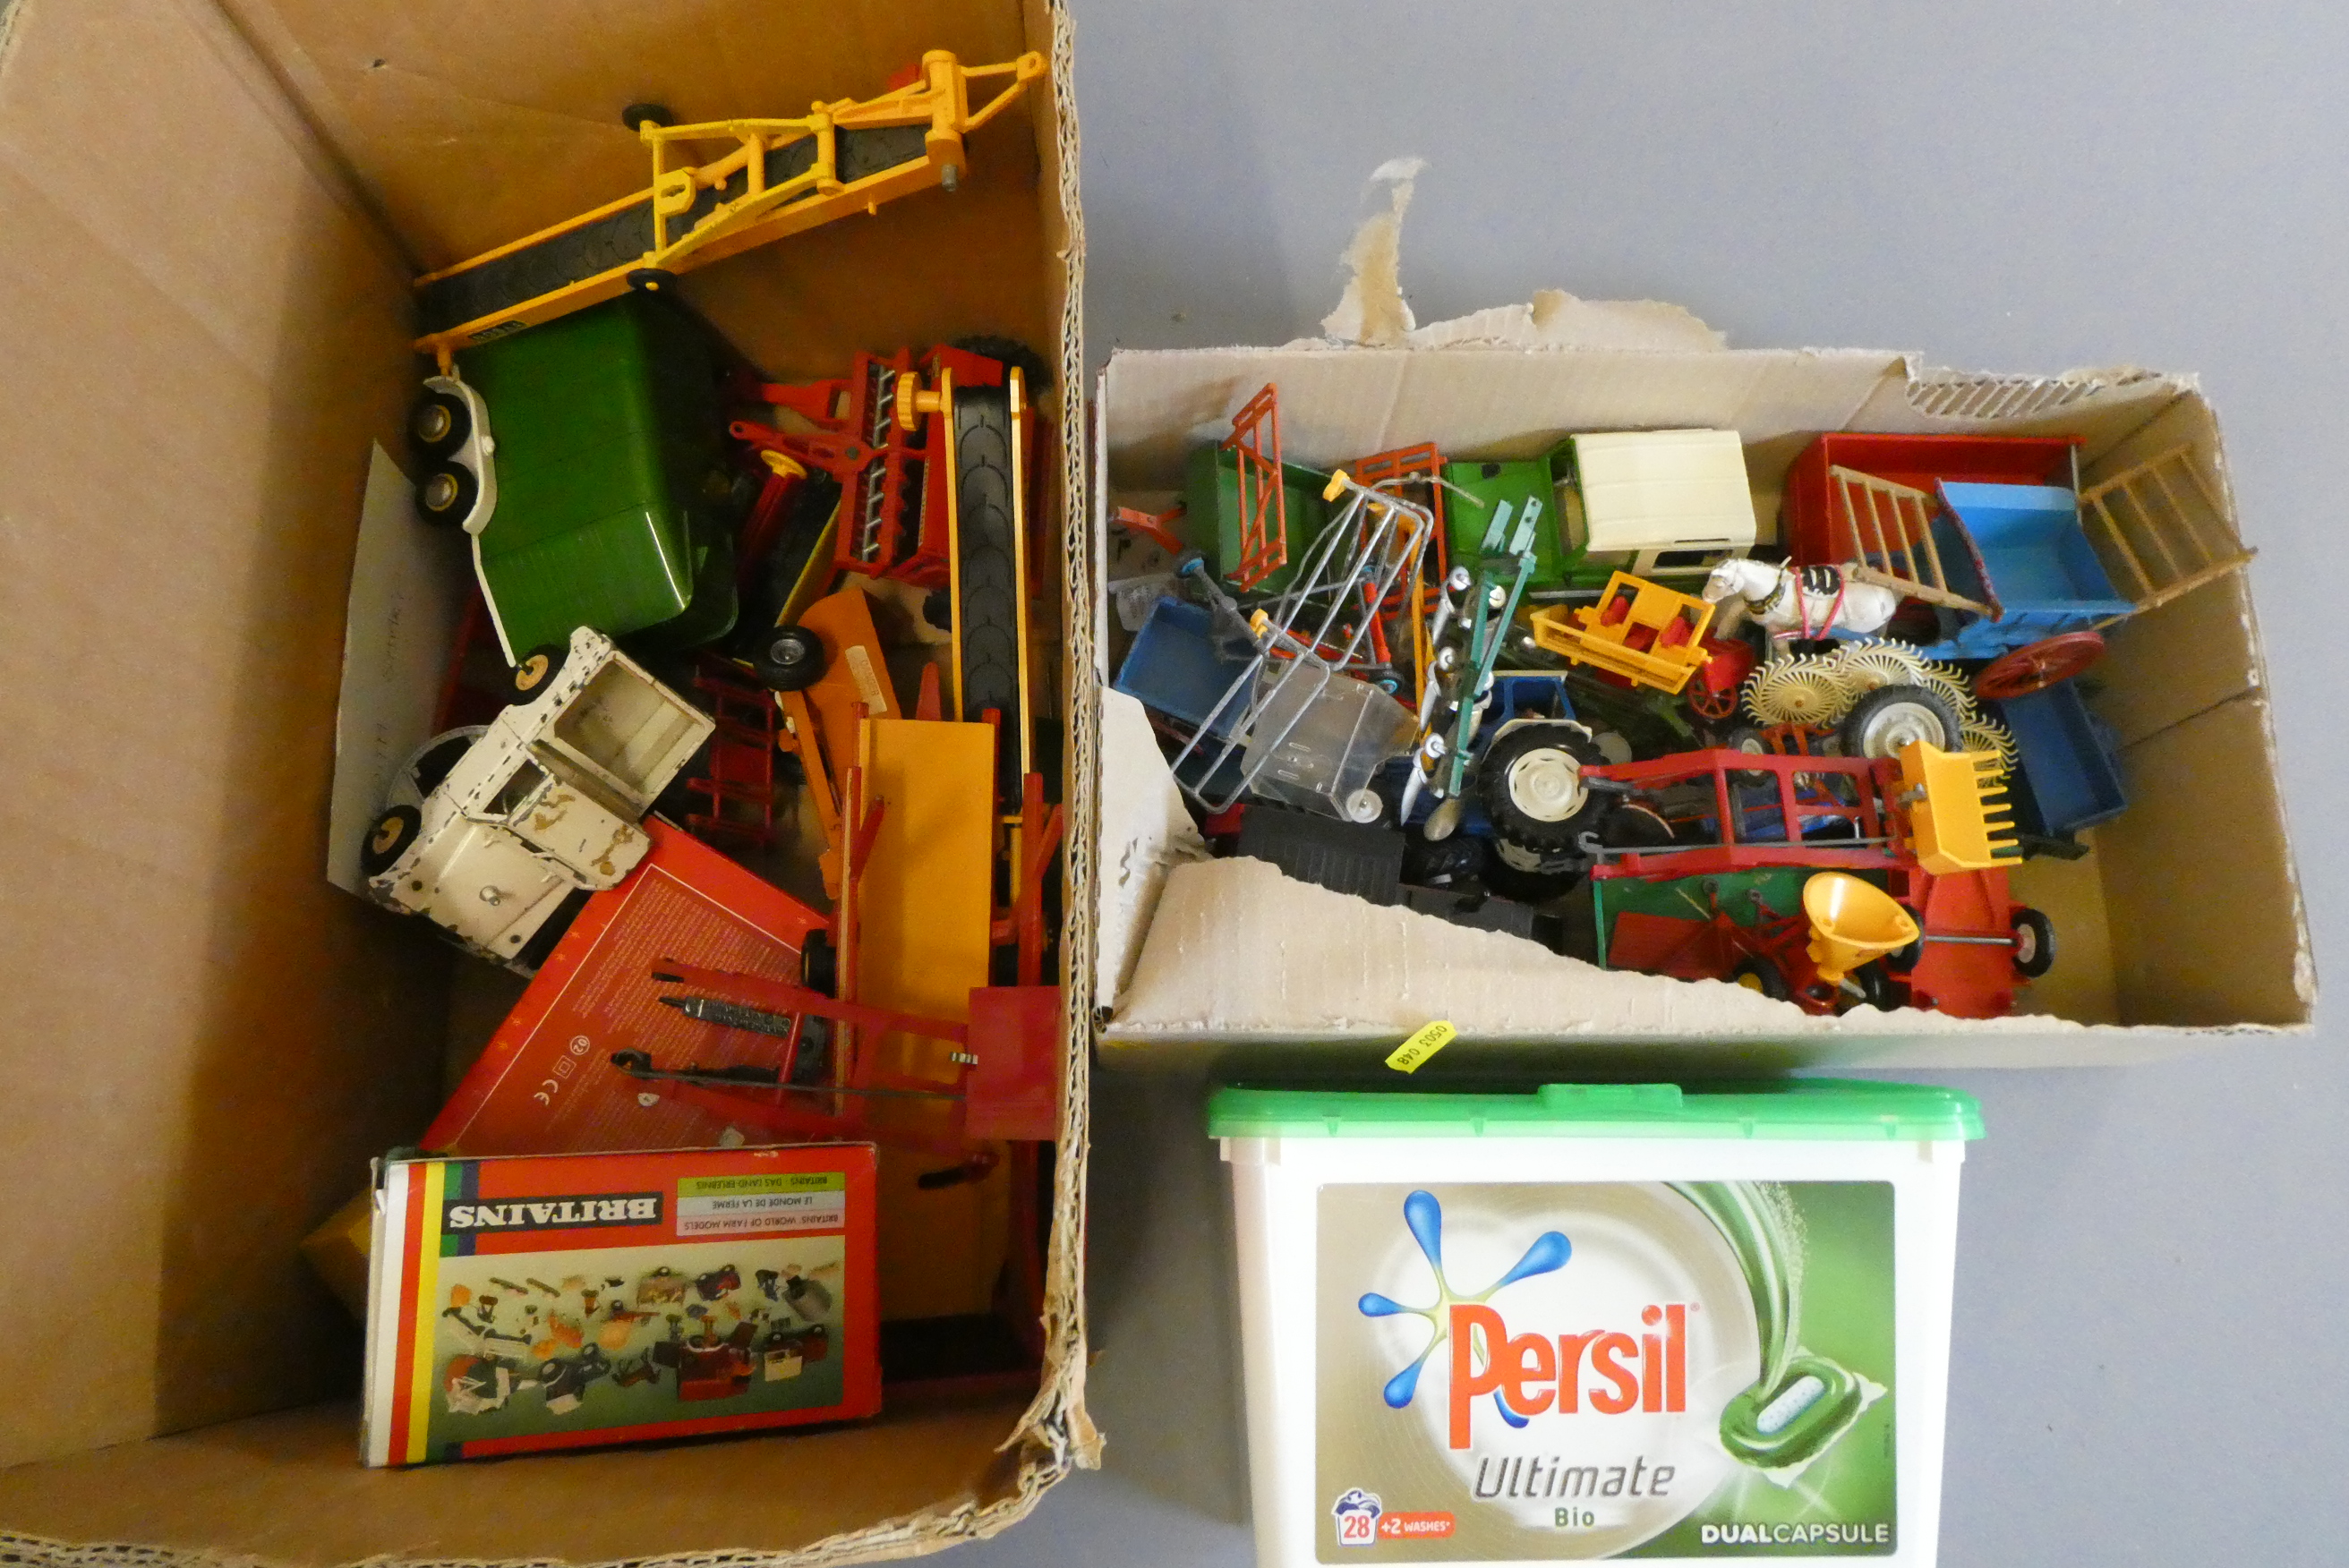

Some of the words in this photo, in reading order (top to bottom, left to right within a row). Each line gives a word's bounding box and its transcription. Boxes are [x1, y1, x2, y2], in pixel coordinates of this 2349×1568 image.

[1419, 1025, 1448, 1047] 0503
[1397, 1048, 1420, 1065] 048
[764, 1178, 782, 1187] DAS
[790, 1175, 828, 1185] BRITAINS
[713, 1200, 739, 1210] FERME
[742, 1199, 752, 1208] LA
[756, 1199, 766, 1207] DE
[769, 1197, 801, 1207] MONDE
[804, 1196, 813, 1205] LE
[449, 1197, 657, 1229] BRITAINS
[684, 1221, 721, 1230] MODELS
[724, 1220, 747, 1228] FARM
[750, 1218, 762, 1227] OF
[764, 1216, 796, 1226] WORLD
[1449, 1304, 1686, 1449] Persil
[1474, 1455, 1676, 1498] Ultimate
[1554, 1507, 1595, 1528] Bio
[1344, 1514, 1371, 1538] 28
[1381, 1518, 1402, 1534] +2
